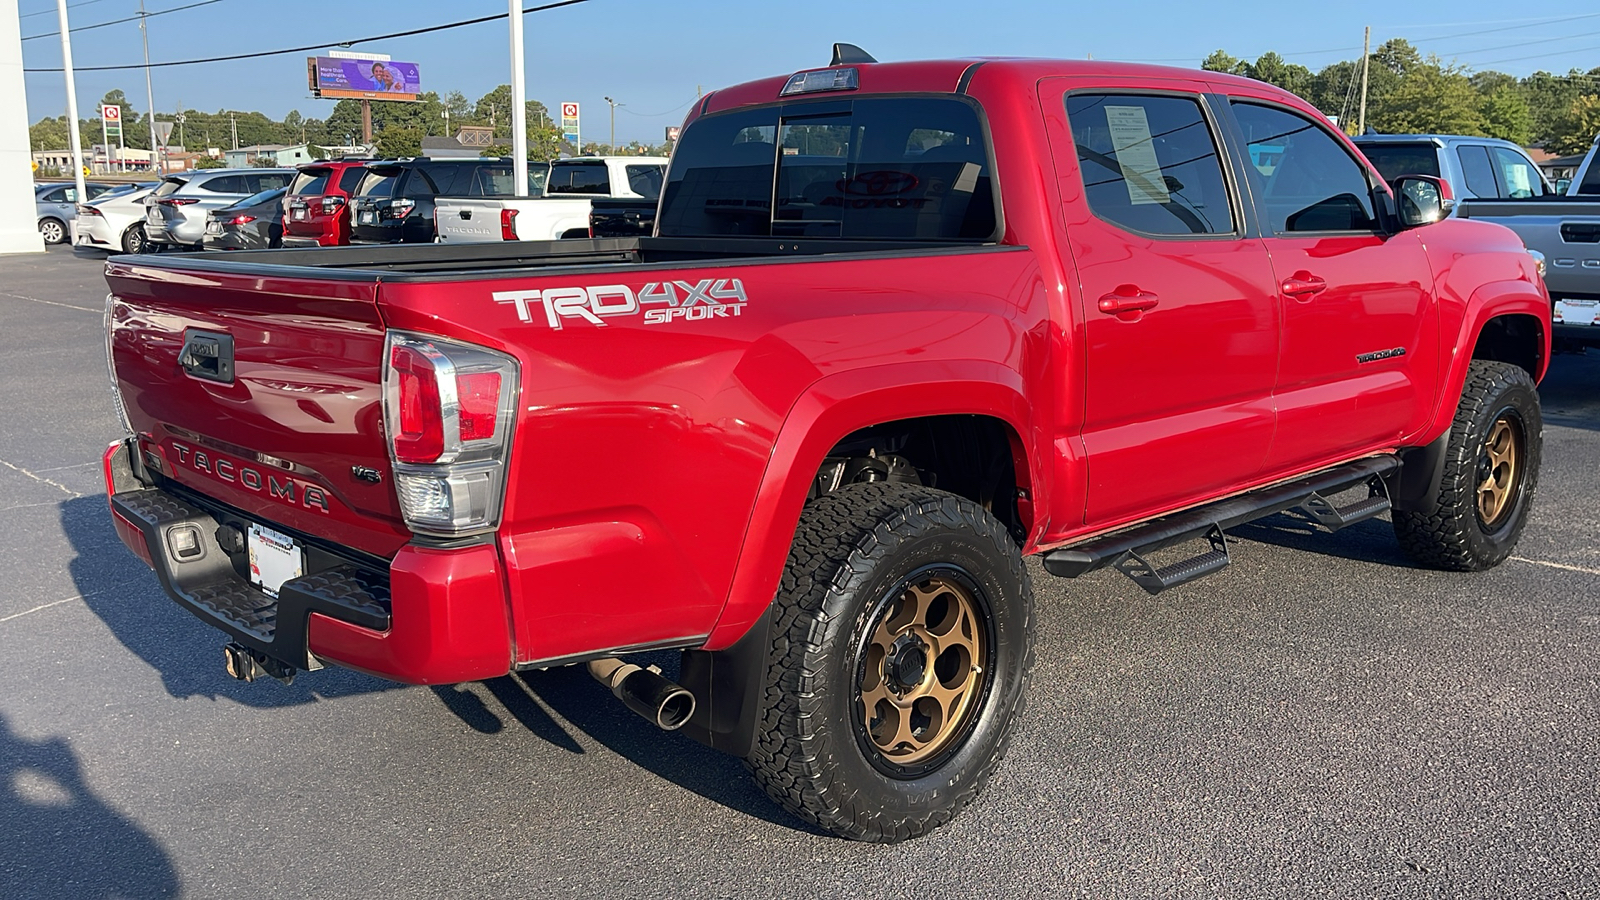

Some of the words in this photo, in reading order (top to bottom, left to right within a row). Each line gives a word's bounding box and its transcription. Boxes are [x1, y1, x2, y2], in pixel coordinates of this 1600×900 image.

[445, 226, 492, 235] TACOMA
[491, 284, 640, 330] TRD
[643, 302, 748, 325] SPORT
[172, 442, 329, 514] TACOMA
[351, 465, 382, 483] V6
